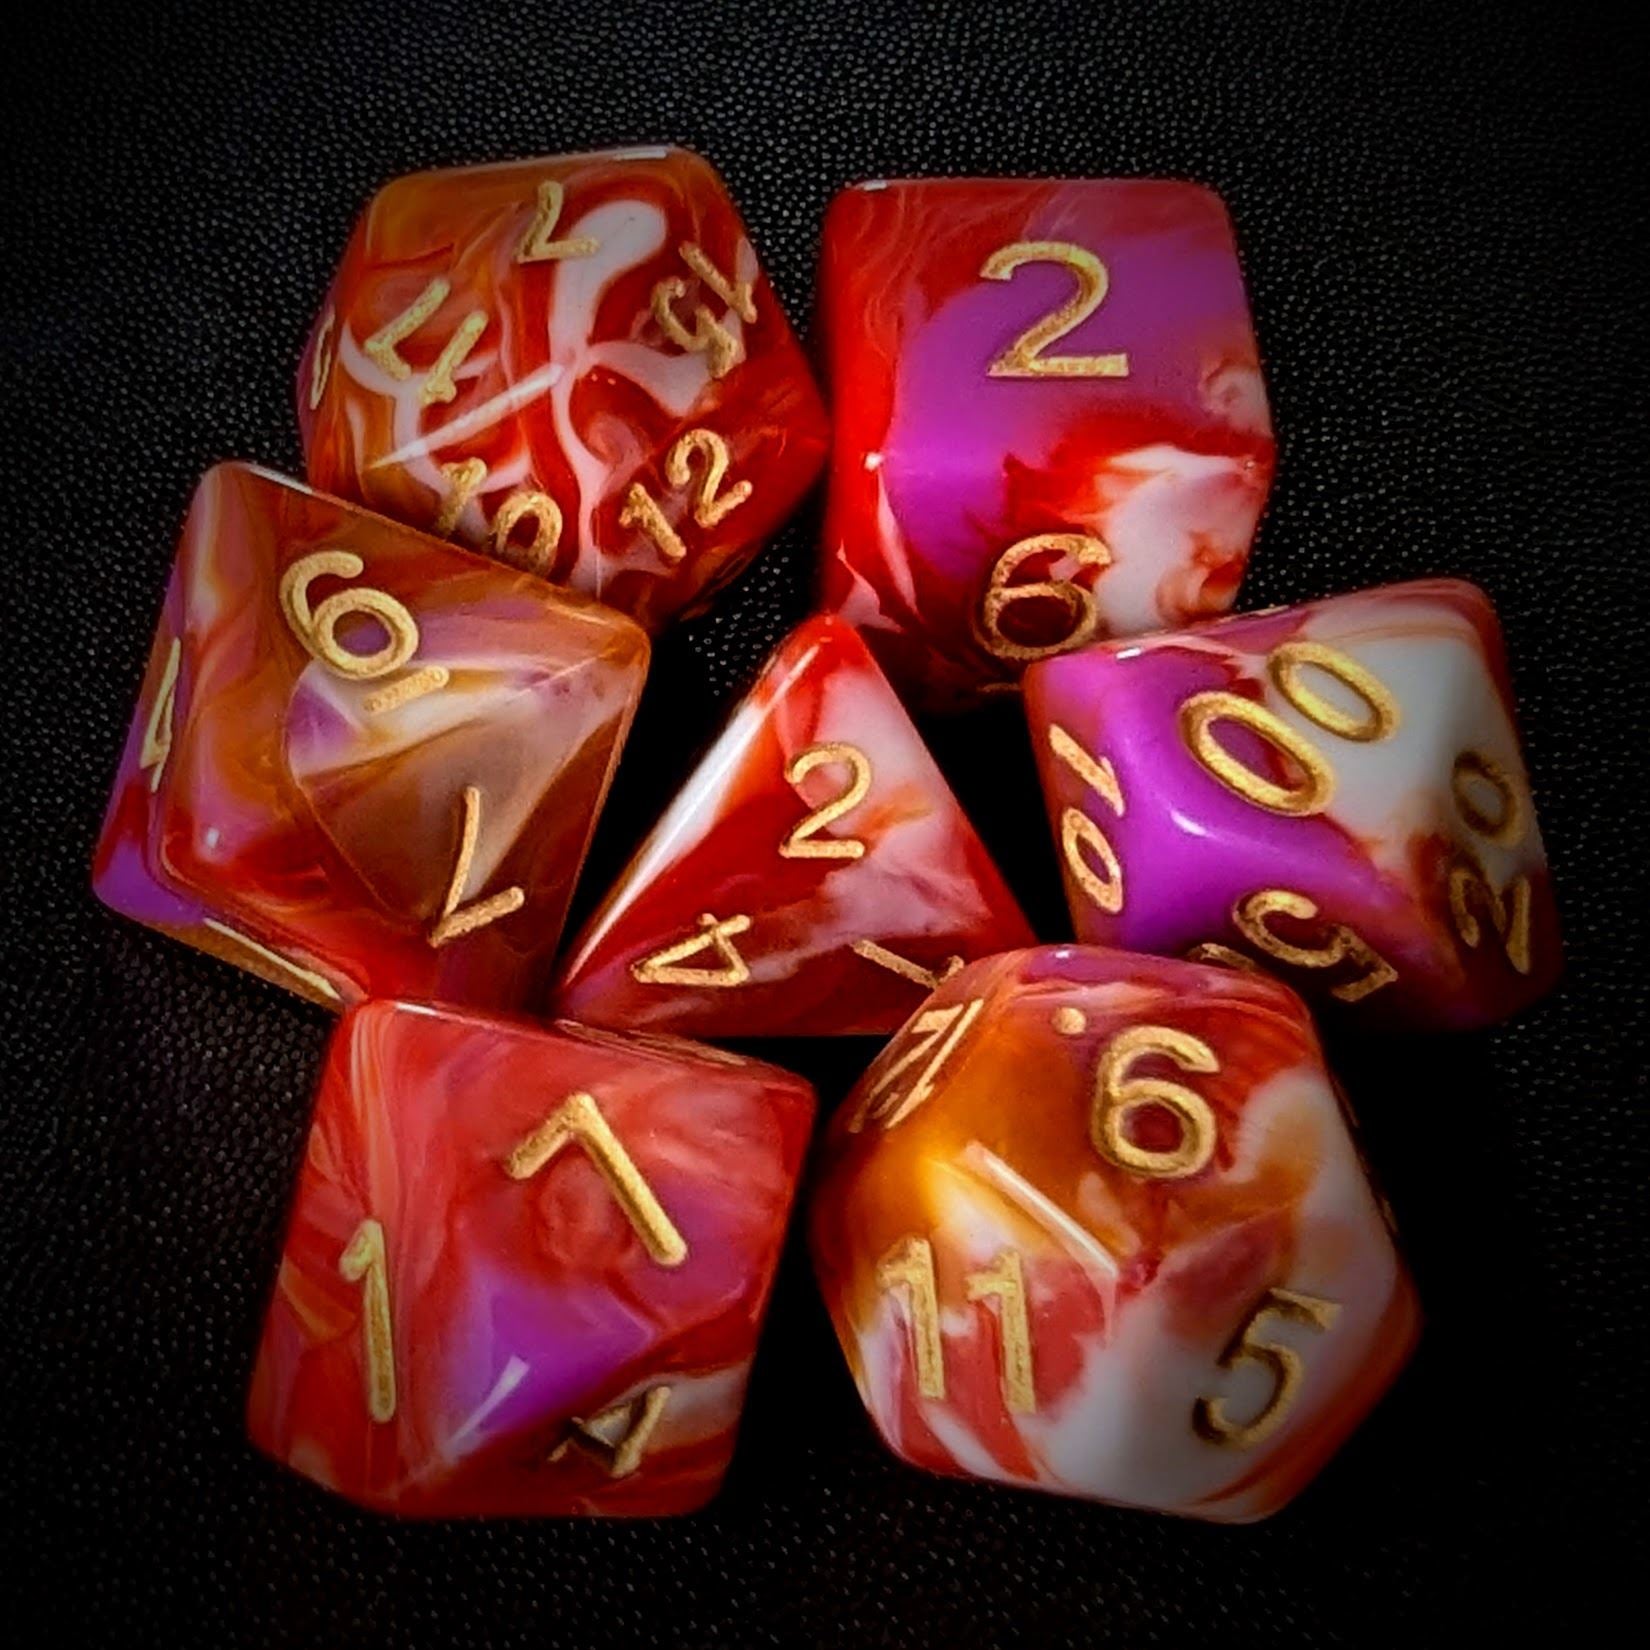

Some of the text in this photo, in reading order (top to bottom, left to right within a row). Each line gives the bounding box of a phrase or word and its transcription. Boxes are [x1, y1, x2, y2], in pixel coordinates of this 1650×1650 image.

[979, 240, 1129, 377] 2
[620, 428, 754, 563] 12
[279, 549, 419, 681] 6
[973, 532, 1113, 661] 6
[1179, 641, 1402, 818] 00
[779, 742, 872, 858] 2
[632, 912, 752, 989] 4
[508, 1091, 688, 1268] 7
[338, 1217, 397, 1423] 1
[874, 1236, 1038, 1415] 11
[1190, 1286, 1343, 1451] 5
[549, 1386, 672, 1480] 4
